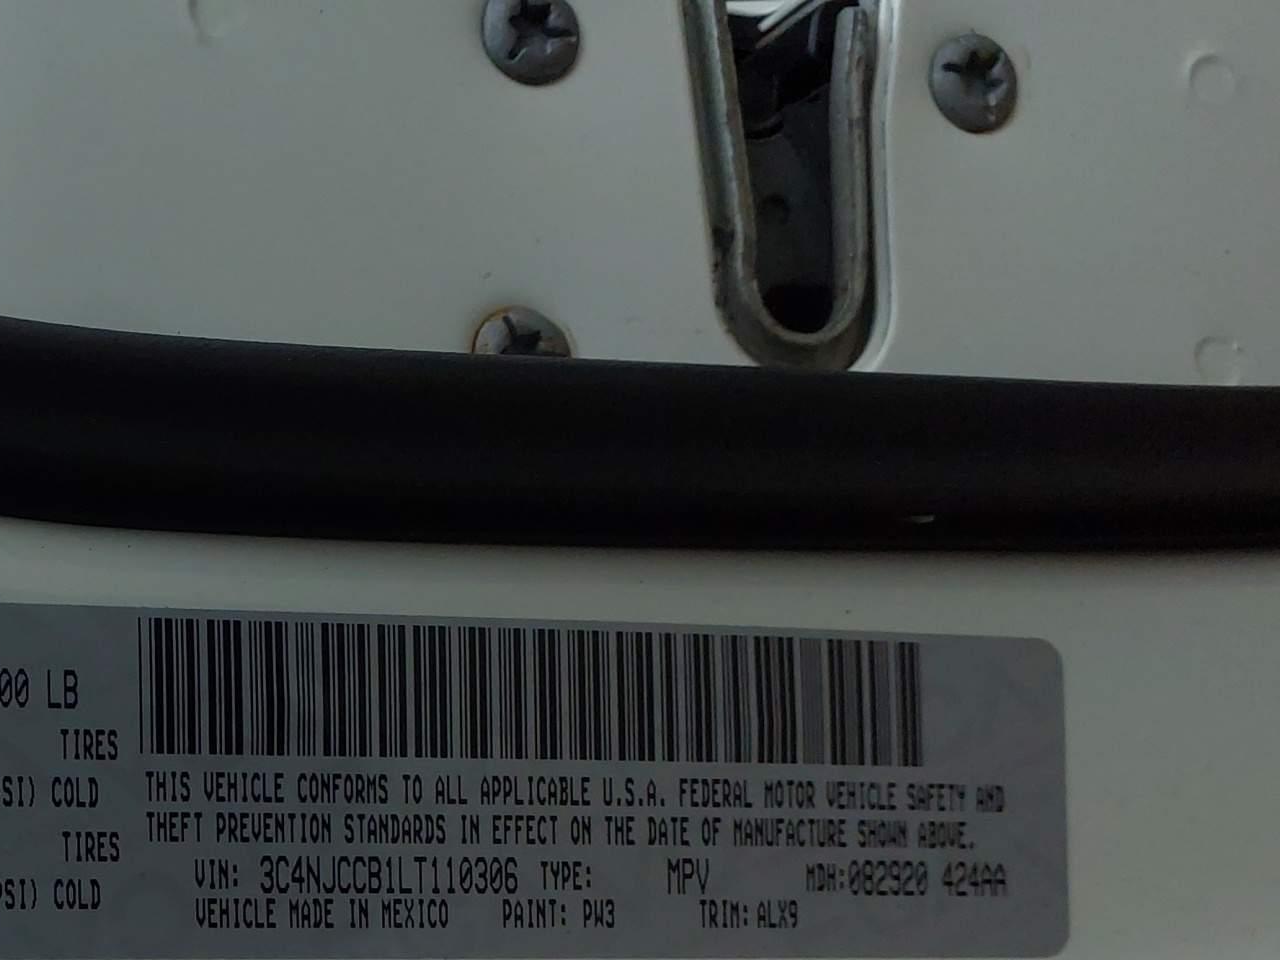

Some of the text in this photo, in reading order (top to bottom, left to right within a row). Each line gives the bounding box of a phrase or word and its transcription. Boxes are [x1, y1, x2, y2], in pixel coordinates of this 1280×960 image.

[47, 670, 78, 709] LB
[61, 729, 117, 760] TIRES
[52, 777, 98, 808] COLD
[146, 771, 1004, 812] THIS VEHICLE CONFORMS TO ALL APPLICABLE U.S.A. FEDERAL MOTOR VEHICLE SAFETY AND
[146, 812, 974, 849] THEFT PREVENTION STANDARDS IN EFFECT ON THE DATE OF MANUFACTURE SHOWN ABOVE.
[62, 831, 119, 862] TIRES
[195, 859, 238, 889] VIN:
[259, 856, 518, 895] 3C4NJCCB1LT110306
[541, 861, 591, 890] TYPE:
[668, 858, 709, 895] MPV
[54, 879, 100, 909] COLD
[196, 898, 797, 928] VEHICLE MADE IN MEXICO PAINT: PW3 TRIM: ALX9
